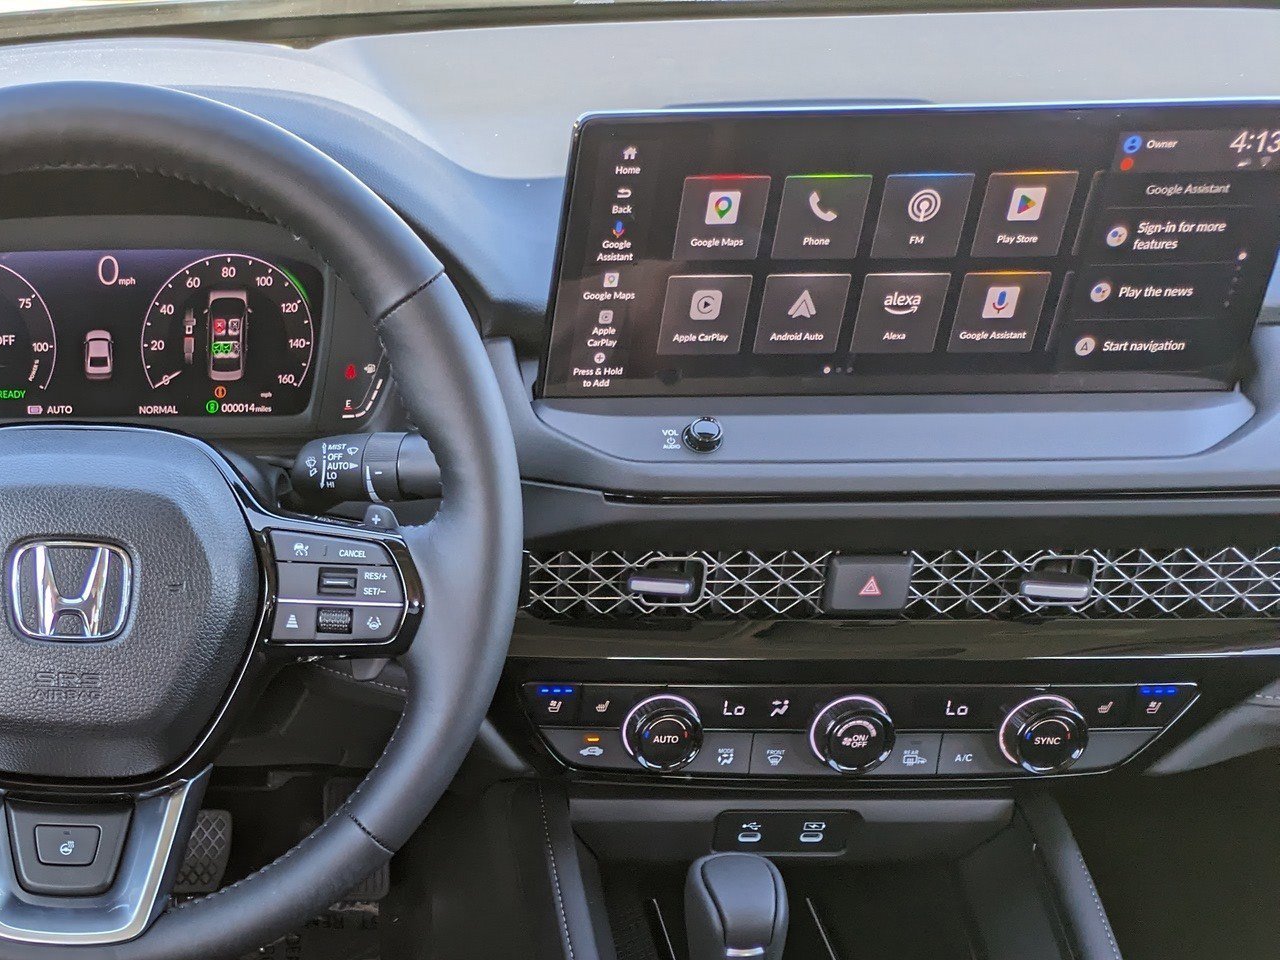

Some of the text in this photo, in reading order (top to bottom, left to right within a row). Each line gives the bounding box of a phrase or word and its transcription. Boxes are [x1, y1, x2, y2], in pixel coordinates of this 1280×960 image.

[1146, 139, 1178, 149] Owner
[1229, 130, 1280, 153] 4:13
[615, 166, 641, 175] Home
[1146, 182, 1231, 195] Google Assistant
[611, 205, 632, 214] Back
[1137, 221, 1227, 235] Sign-in for more
[690, 237, 744, 248] Google Maps
[803, 236, 830, 246] Phone
[909, 235, 924, 244] FM
[997, 234, 1038, 244] Play Store
[1132, 238, 1178, 250] features
[602, 240, 632, 250] Google
[596, 252, 633, 262] Assistant
[98, 255, 136, 287] 0 mph
[221, 266, 236, 278] 80
[186, 276, 201, 288] 60
[255, 275, 273, 287] 100
[583, 291, 636, 301] Google Maps
[1118, 285, 1193, 299] Play the news
[19, 298, 32, 309] 75
[883, 292, 922, 306] alexa
[160, 304, 174, 315] 40
[281, 302, 298, 313] 120
[592, 326, 616, 337] Apple
[882, 331, 906, 341] Alexa
[959, 330, 1027, 341] Google Assistant
[672, 332, 729, 344] Apple CarPlay
[770, 332, 824, 342] Android Auto
[32, 341, 49, 352] 100
[150, 339, 165, 351] 20
[288, 338, 306, 349] 140
[587, 338, 617, 348] CarPlay
[1102, 339, 1186, 353] Start navigation
[572, 366, 623, 376] Press & Hold
[277, 373, 295, 385] 160
[591, 379, 610, 387] Add
[221, 402, 272, 414] 000014 miles
[345, 399, 352, 408] E
[46, 405, 73, 415] AUTO
[139, 404, 178, 415] NORMAL
[328, 443, 347, 451] MIST
[327, 453, 342, 461] OFF
[327, 462, 349, 470] AUTO
[326, 472, 337, 480] LO
[338, 549, 367, 558] CANCEL
[653, 735, 679, 745] AUTO
[851, 734, 869, 743] ON/
[1034, 736, 1061, 746] SYNC
[851, 741, 868, 749] OFF
[954, 753, 973, 763] A/C
